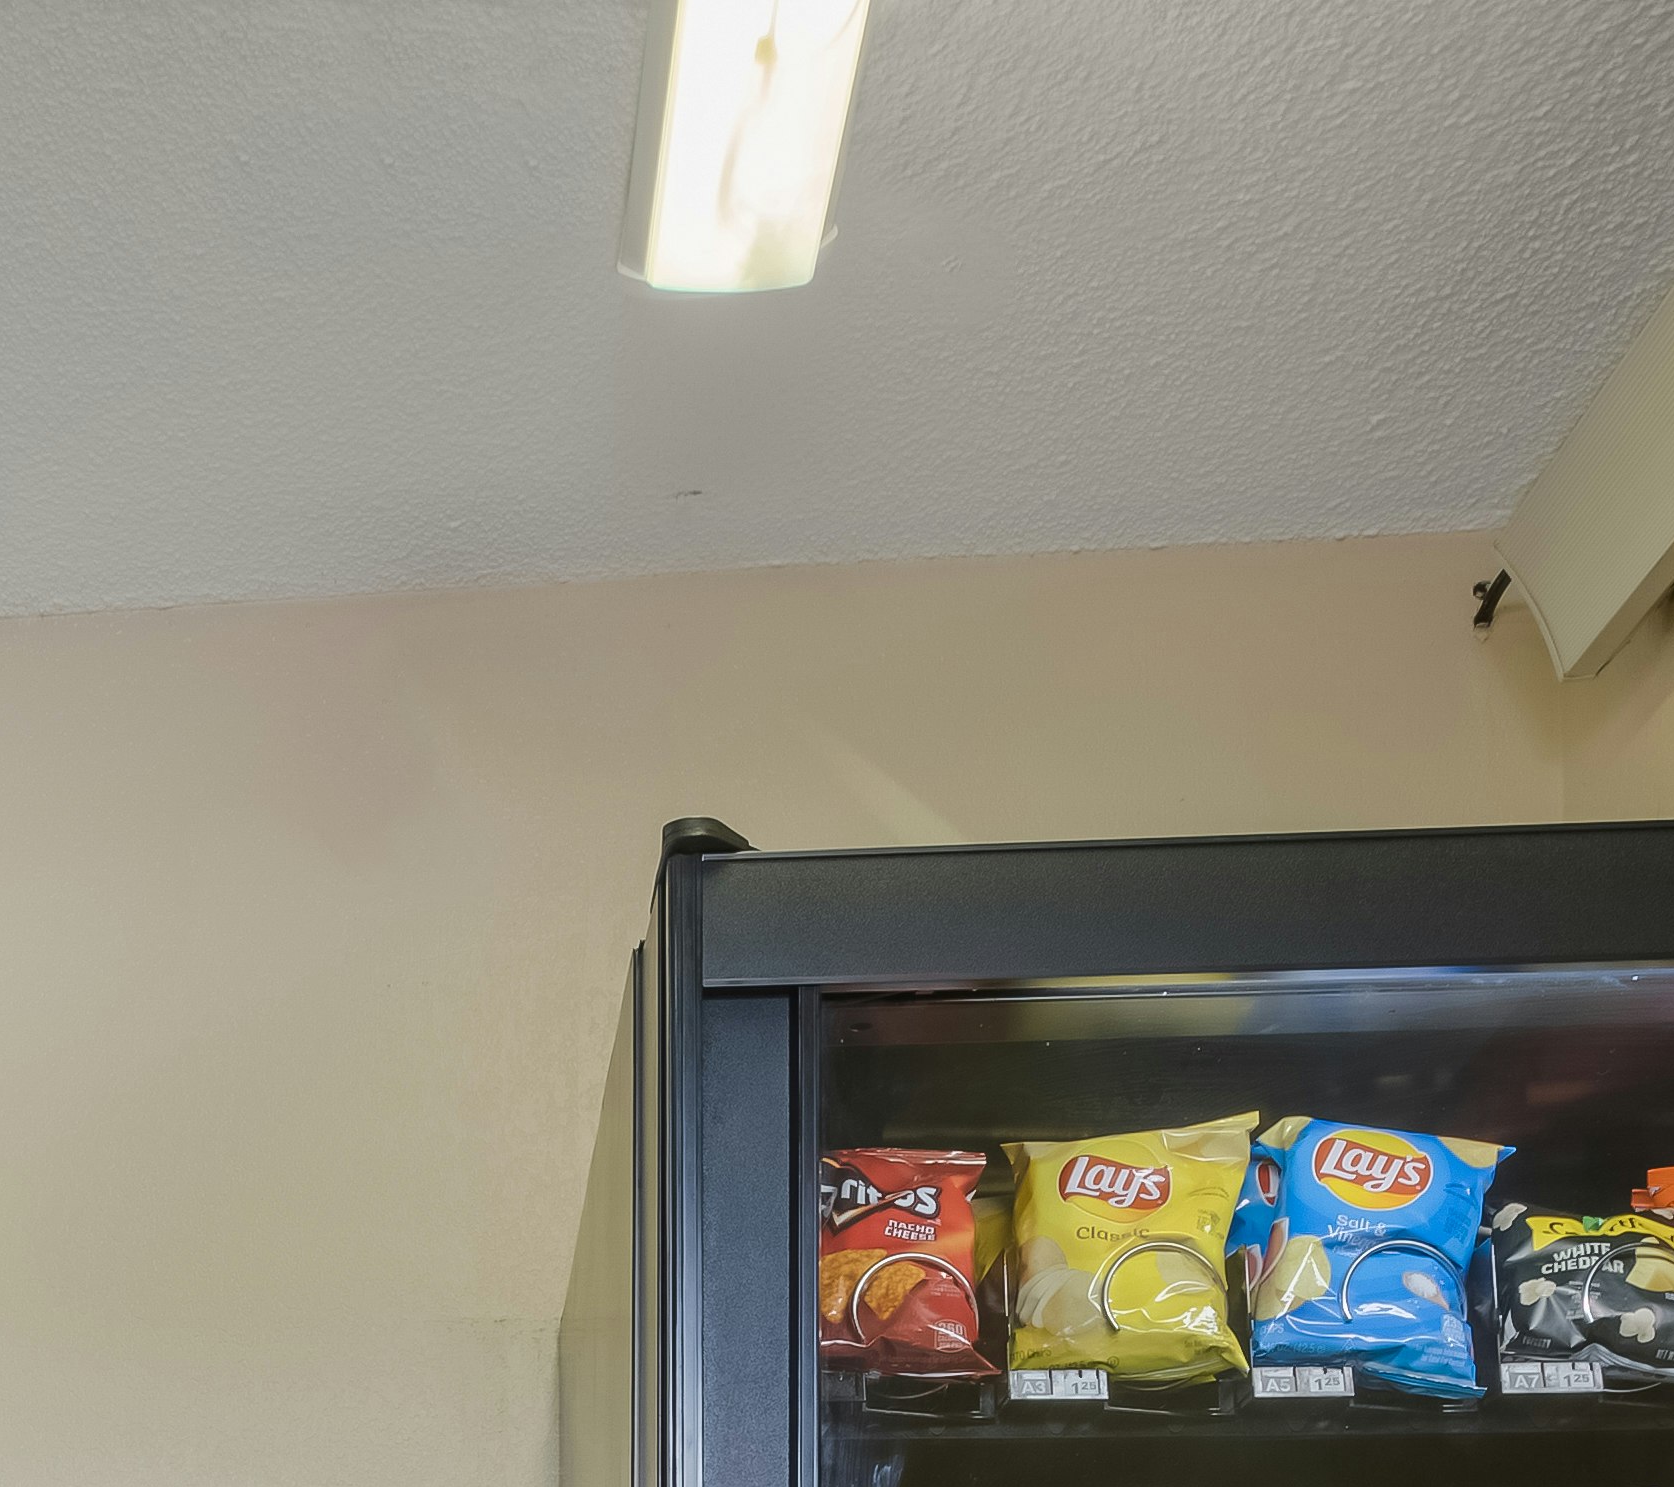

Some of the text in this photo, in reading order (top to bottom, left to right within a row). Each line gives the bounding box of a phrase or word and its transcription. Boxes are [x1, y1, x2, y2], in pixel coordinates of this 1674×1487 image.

[1319, 1138, 1425, 1192] Lay's
[1066, 1154, 1169, 1206] Lay's
[889, 1219, 936, 1235] NACHO
[1337, 1214, 1368, 1228] Salt
[884, 1226, 936, 1241] CHEESE
[1077, 1225, 1150, 1242] Classic
[1553, 1242, 1611, 1262] WHITE
[1022, 1381, 1046, 1395] A3
[1266, 1378, 1292, 1392] A5
[1515, 1375, 1540, 1389] A7
